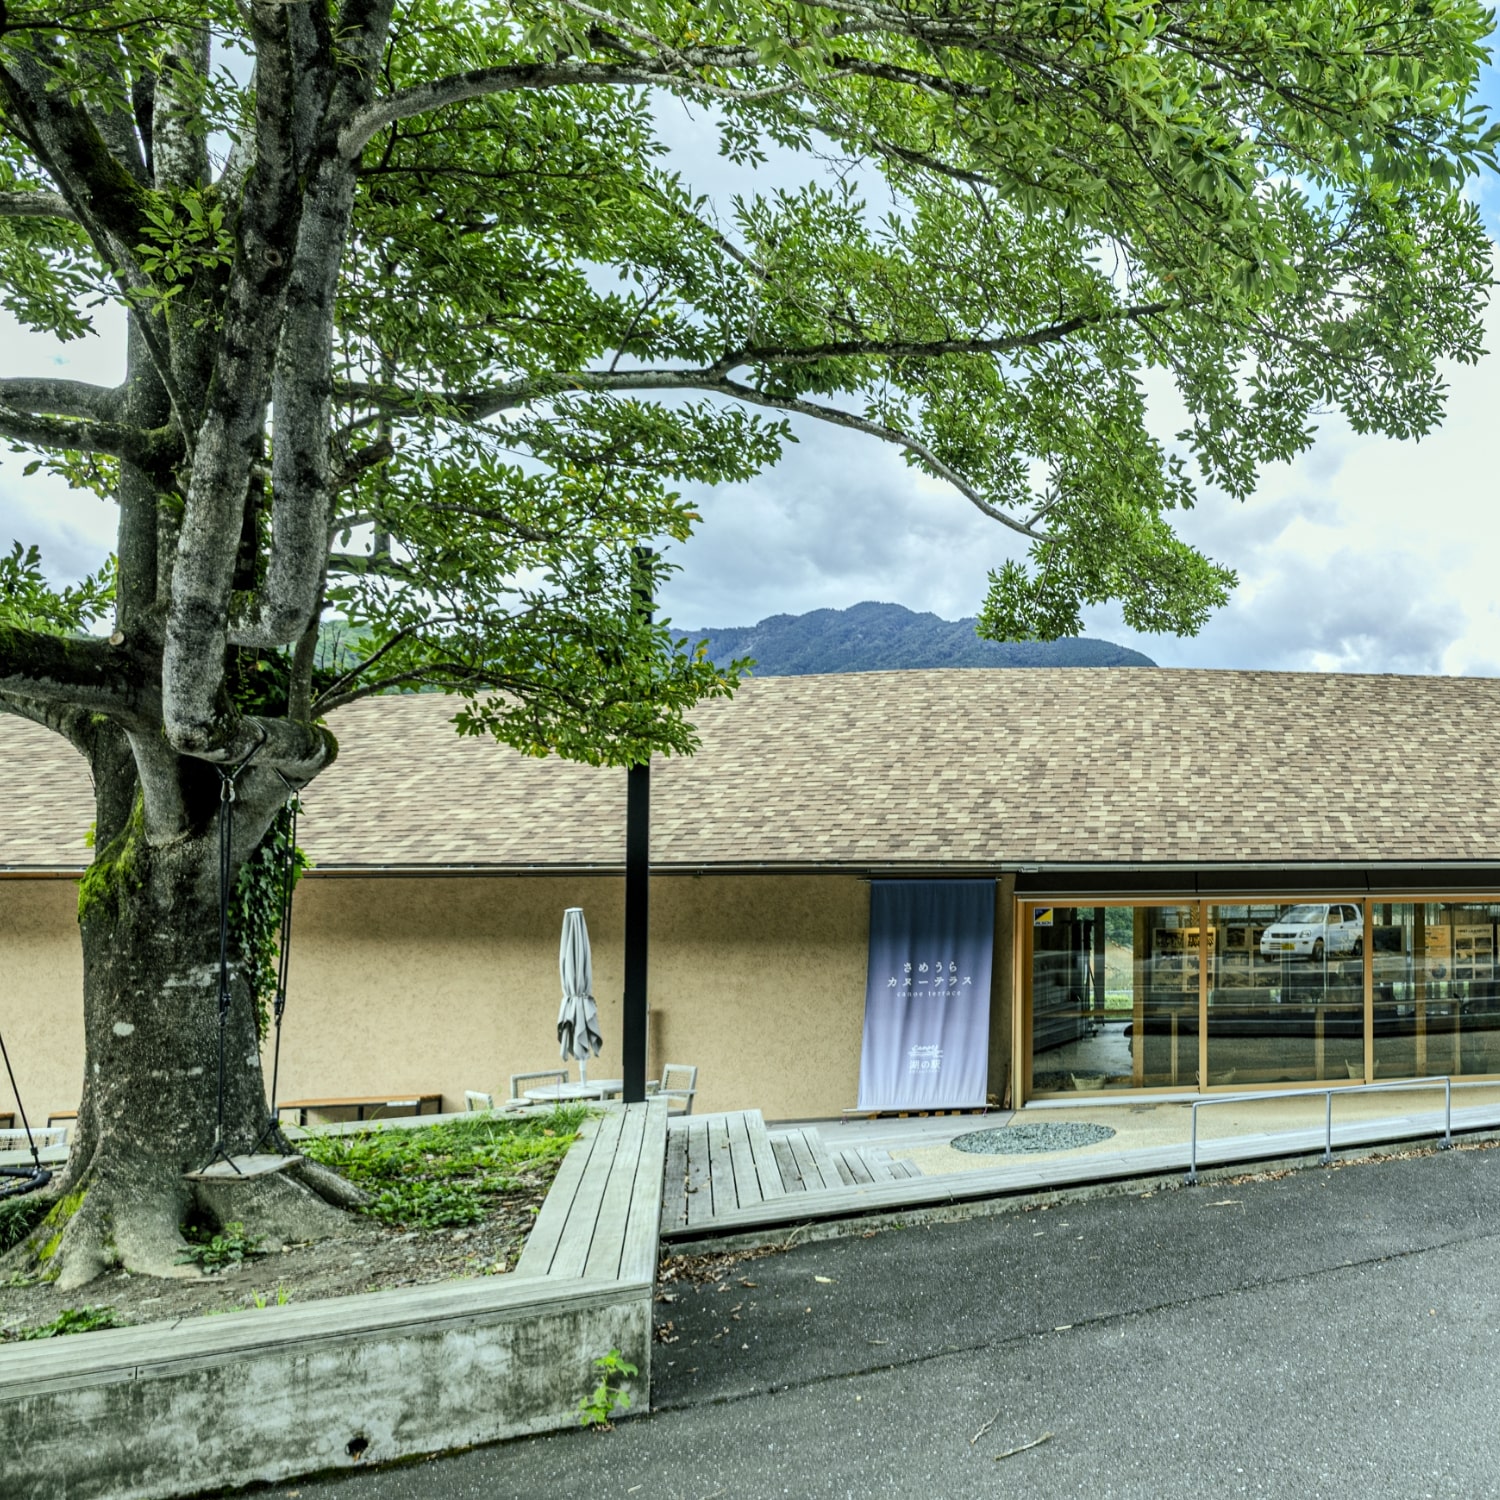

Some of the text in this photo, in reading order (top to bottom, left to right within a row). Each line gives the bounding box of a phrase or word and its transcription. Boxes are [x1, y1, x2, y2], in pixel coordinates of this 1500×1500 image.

[903, 961, 957, 973] さめうら
[887, 976, 972, 987] カヌーテラス
